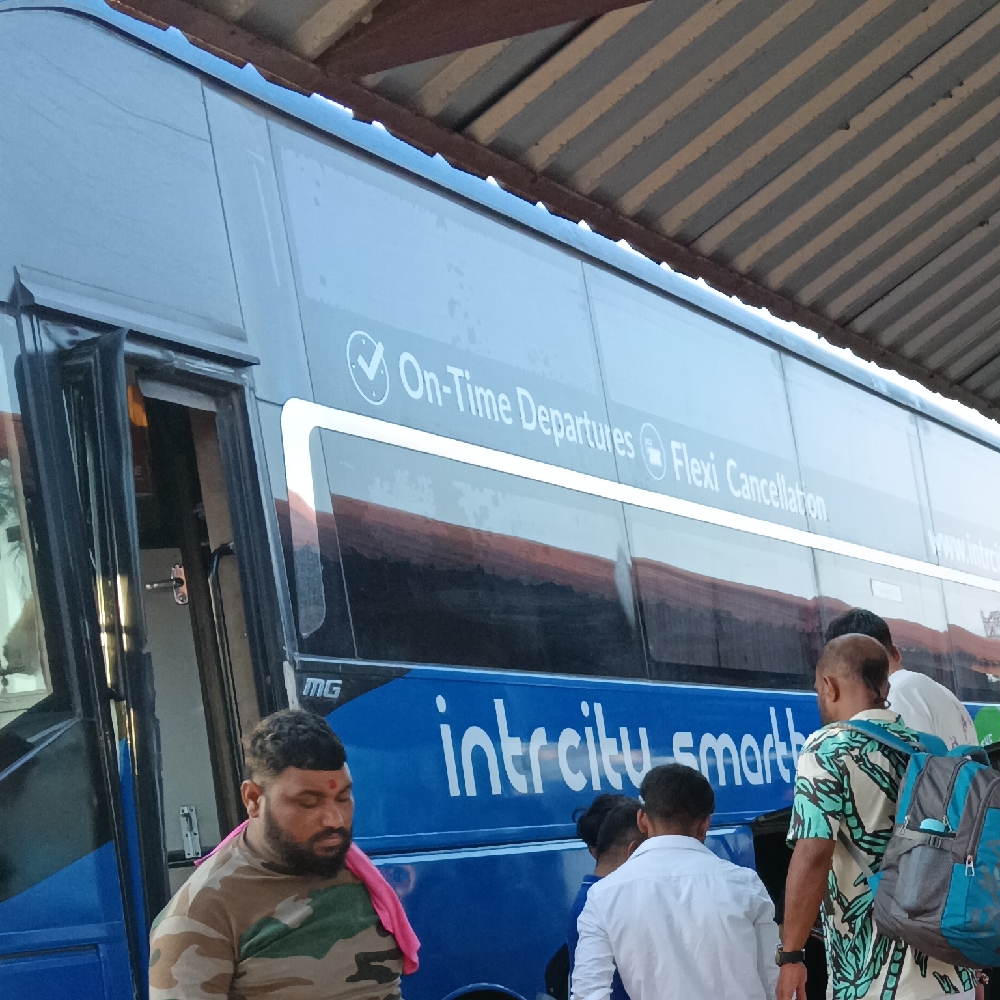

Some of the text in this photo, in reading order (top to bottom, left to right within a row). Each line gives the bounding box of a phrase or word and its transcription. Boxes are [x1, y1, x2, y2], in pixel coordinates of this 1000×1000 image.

[398, 351, 636, 460] On-Time Departures
[670, 439, 831, 522] Flexi Cancellation
[303, 677, 342, 700] MG
